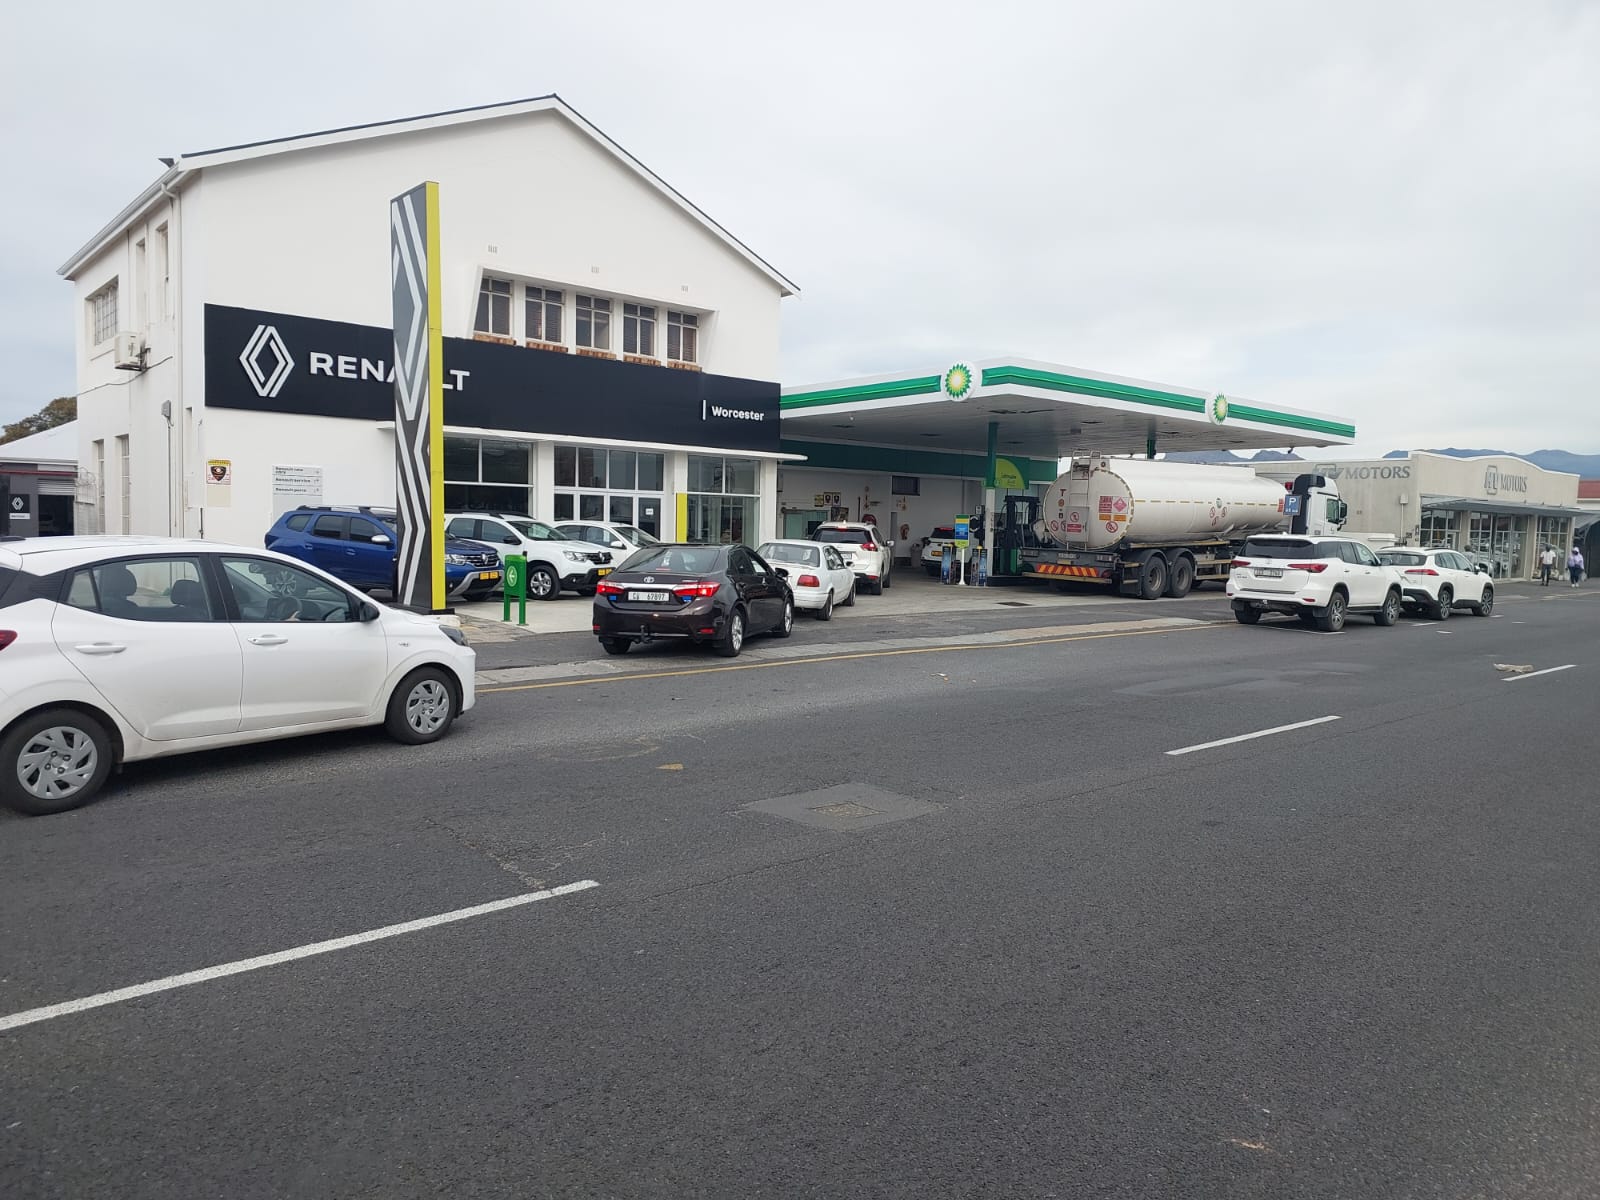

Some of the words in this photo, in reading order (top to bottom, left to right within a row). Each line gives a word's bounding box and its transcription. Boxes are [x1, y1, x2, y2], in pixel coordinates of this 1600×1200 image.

[309, 351, 470, 392] RENT
[711, 405, 765, 421] Worcester
[1345, 465, 1411, 480] MOTORS
[1500, 473, 1528, 493] MOTORS
[1289, 497, 1297, 507] P
